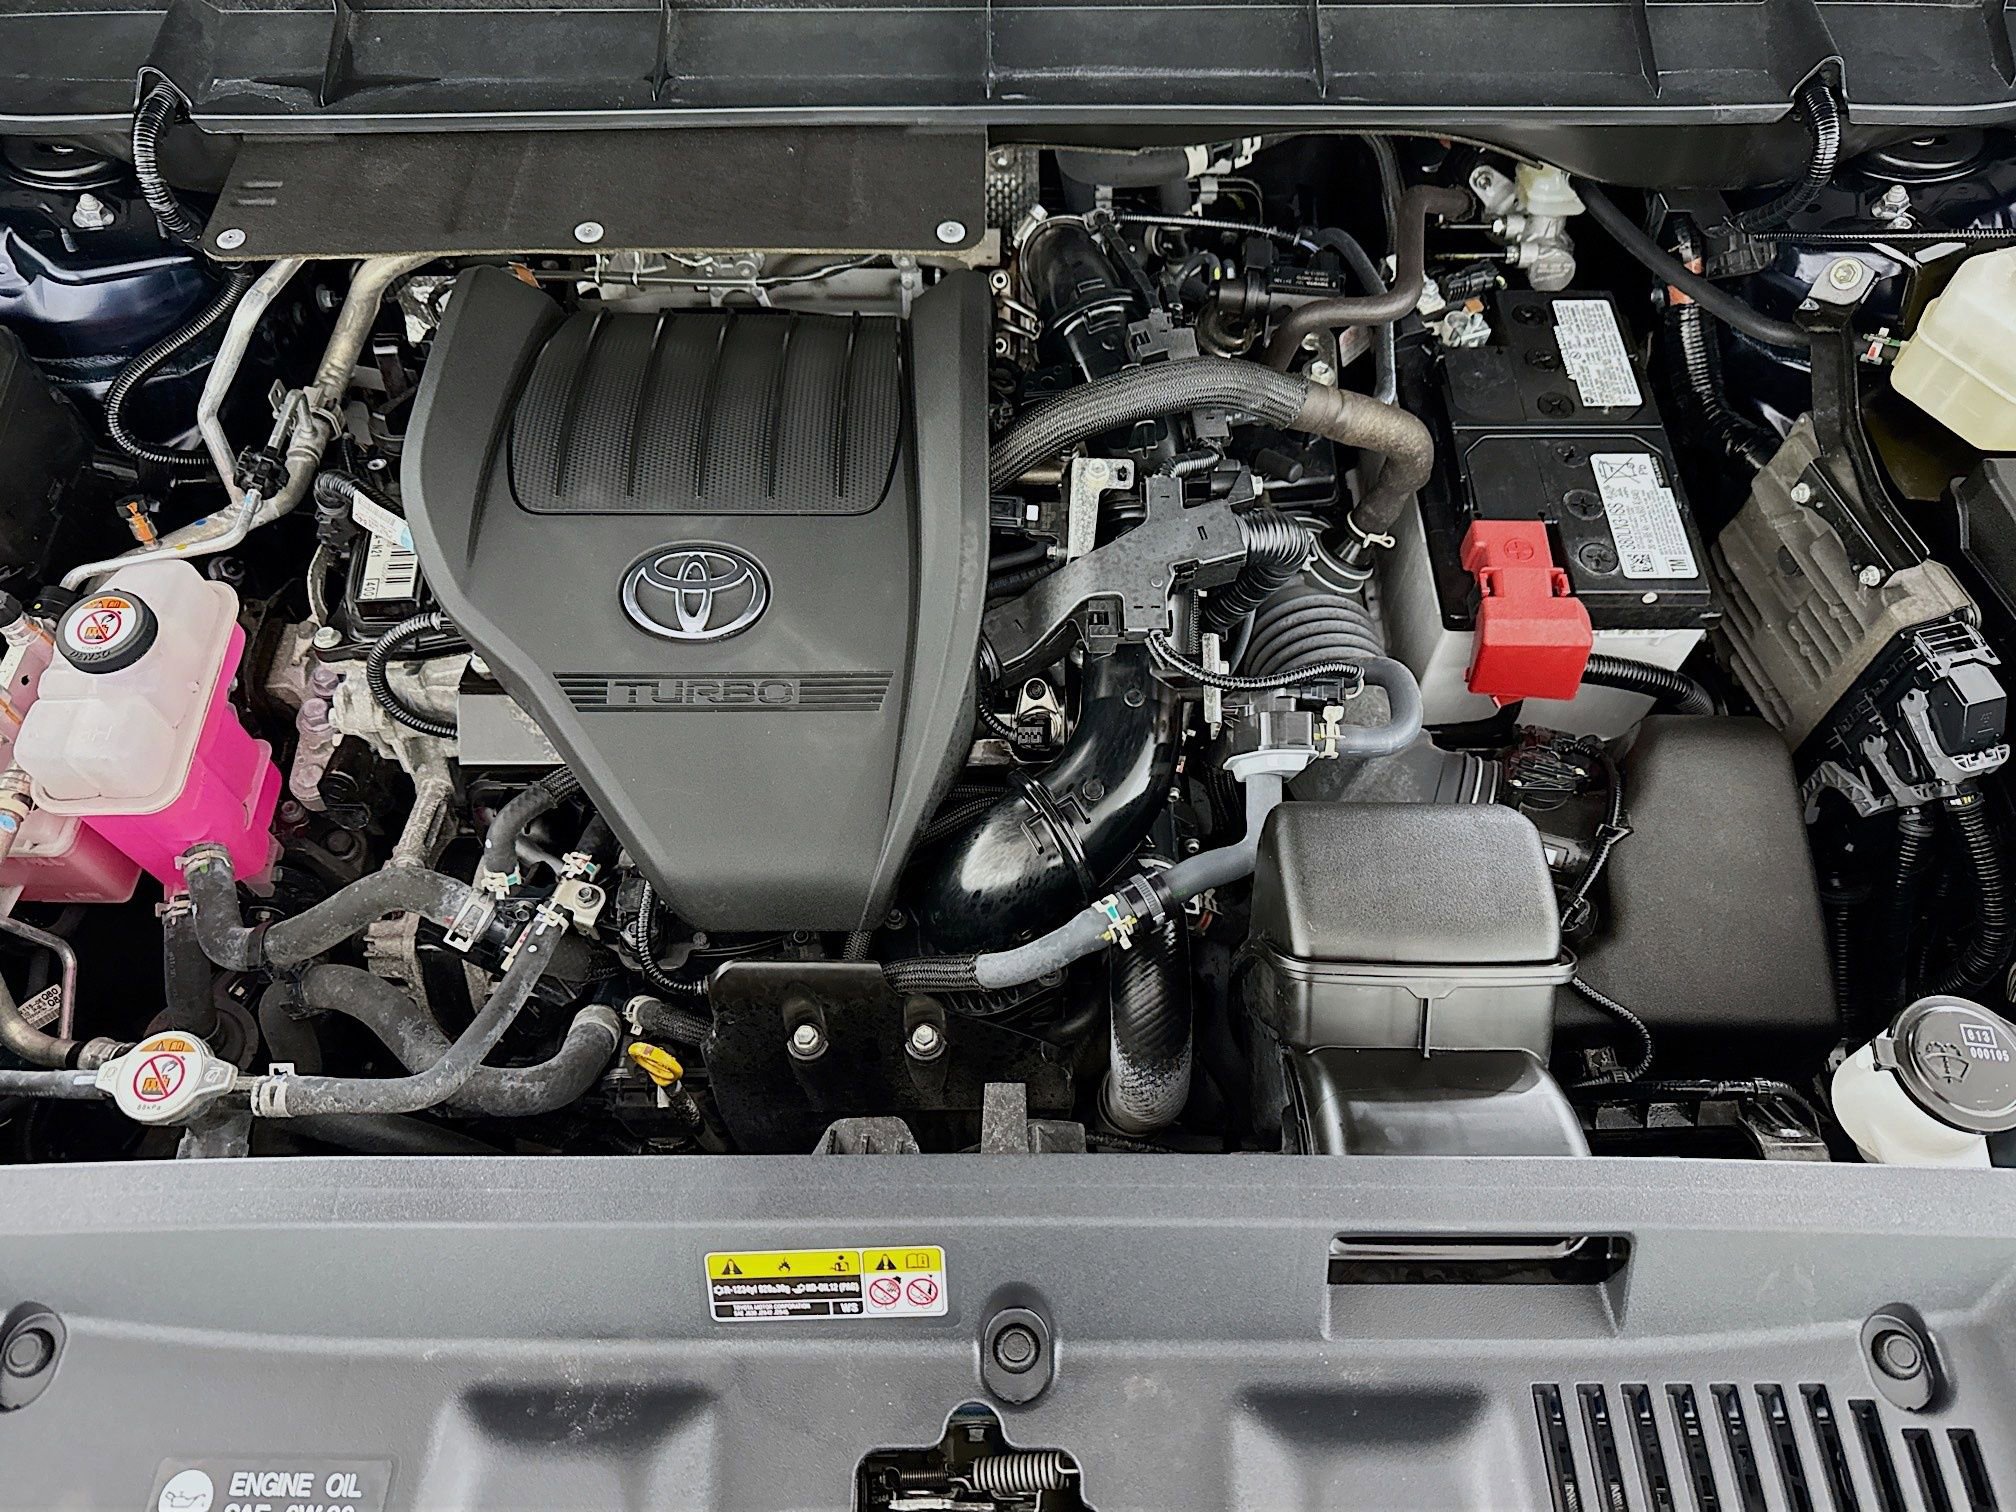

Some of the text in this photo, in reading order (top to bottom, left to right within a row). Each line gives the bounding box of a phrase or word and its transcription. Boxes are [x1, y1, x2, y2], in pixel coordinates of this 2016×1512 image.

[1668, 559, 1688, 572] TM
[69, 649, 110, 661] DENSO
[612, 679, 795, 704] TURBO
[1969, 1046, 2010, 1062] 000105
[840, 1302, 860, 1313] WS
[228, 1471, 362, 1498] ENGINE OIL
